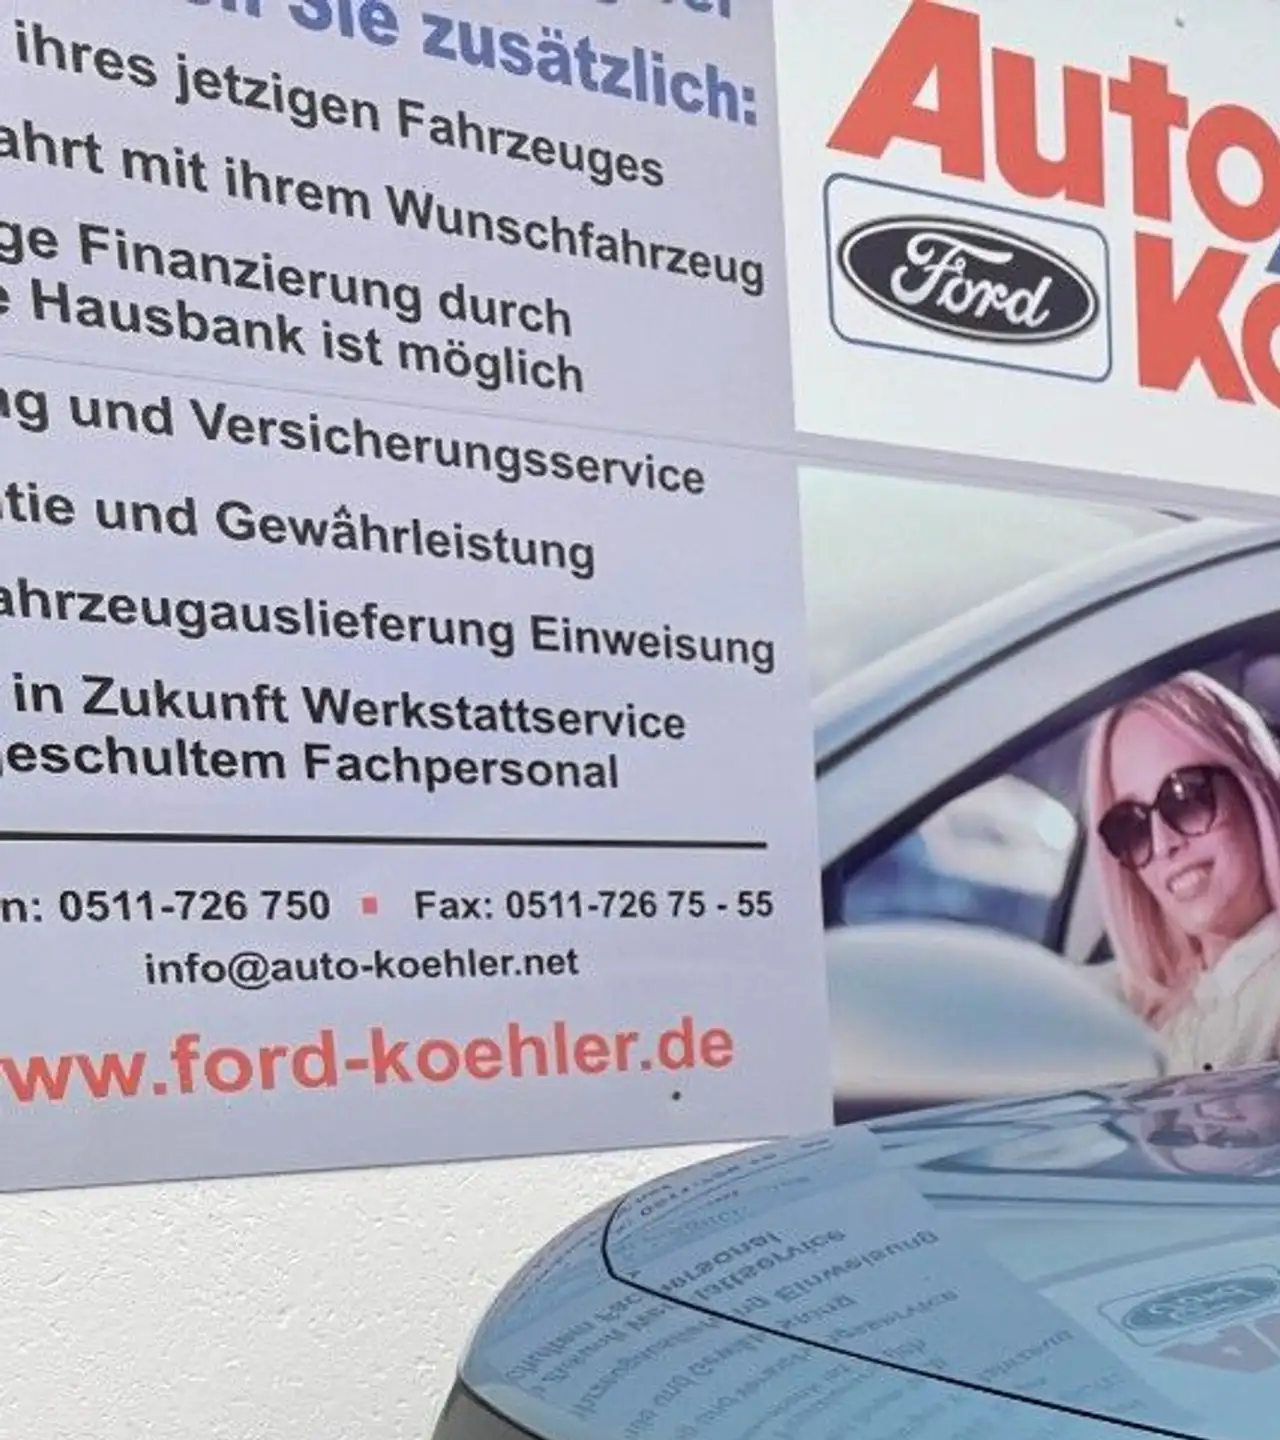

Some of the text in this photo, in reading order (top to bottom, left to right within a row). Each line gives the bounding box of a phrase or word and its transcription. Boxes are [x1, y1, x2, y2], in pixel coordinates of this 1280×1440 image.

[15, 19, 665, 187] ihres jetzigen Fahrzeuges
[422, 13, 757, 126] zusätzlich:
[122, 146, 208, 193] mit
[225, 157, 371, 219] ihrem
[386, 185, 765, 296] Wunschfahrzeug
[79, 223, 421, 324] Finanzierung
[438, 285, 572, 337] durch
[890, 232, 1052, 329] Ford
[31, 278, 306, 354] Hausbank
[323, 326, 382, 367] ist
[399, 340, 584, 394] möglich
[69, 396, 174, 436] und
[190, 399, 706, 495] Versicherungsservice
[0, 482, 595, 579] tie und Gewährleistung
[530, 613, 776, 673] Einweisung
[12, 672, 687, 740] in Zukunft Werkstattservice
[0, 735, 619, 792] eschultem Fachpersonal
[59, 889, 247, 922] 0511-726
[260, 890, 331, 921] 750
[415, 889, 492, 921] Fax:
[505, 889, 658, 919] 0511-726
[667, 889, 706, 919] 75
[736, 889, 774, 919] 55
[145, 948, 579, 990] info@auto-koehler.net
